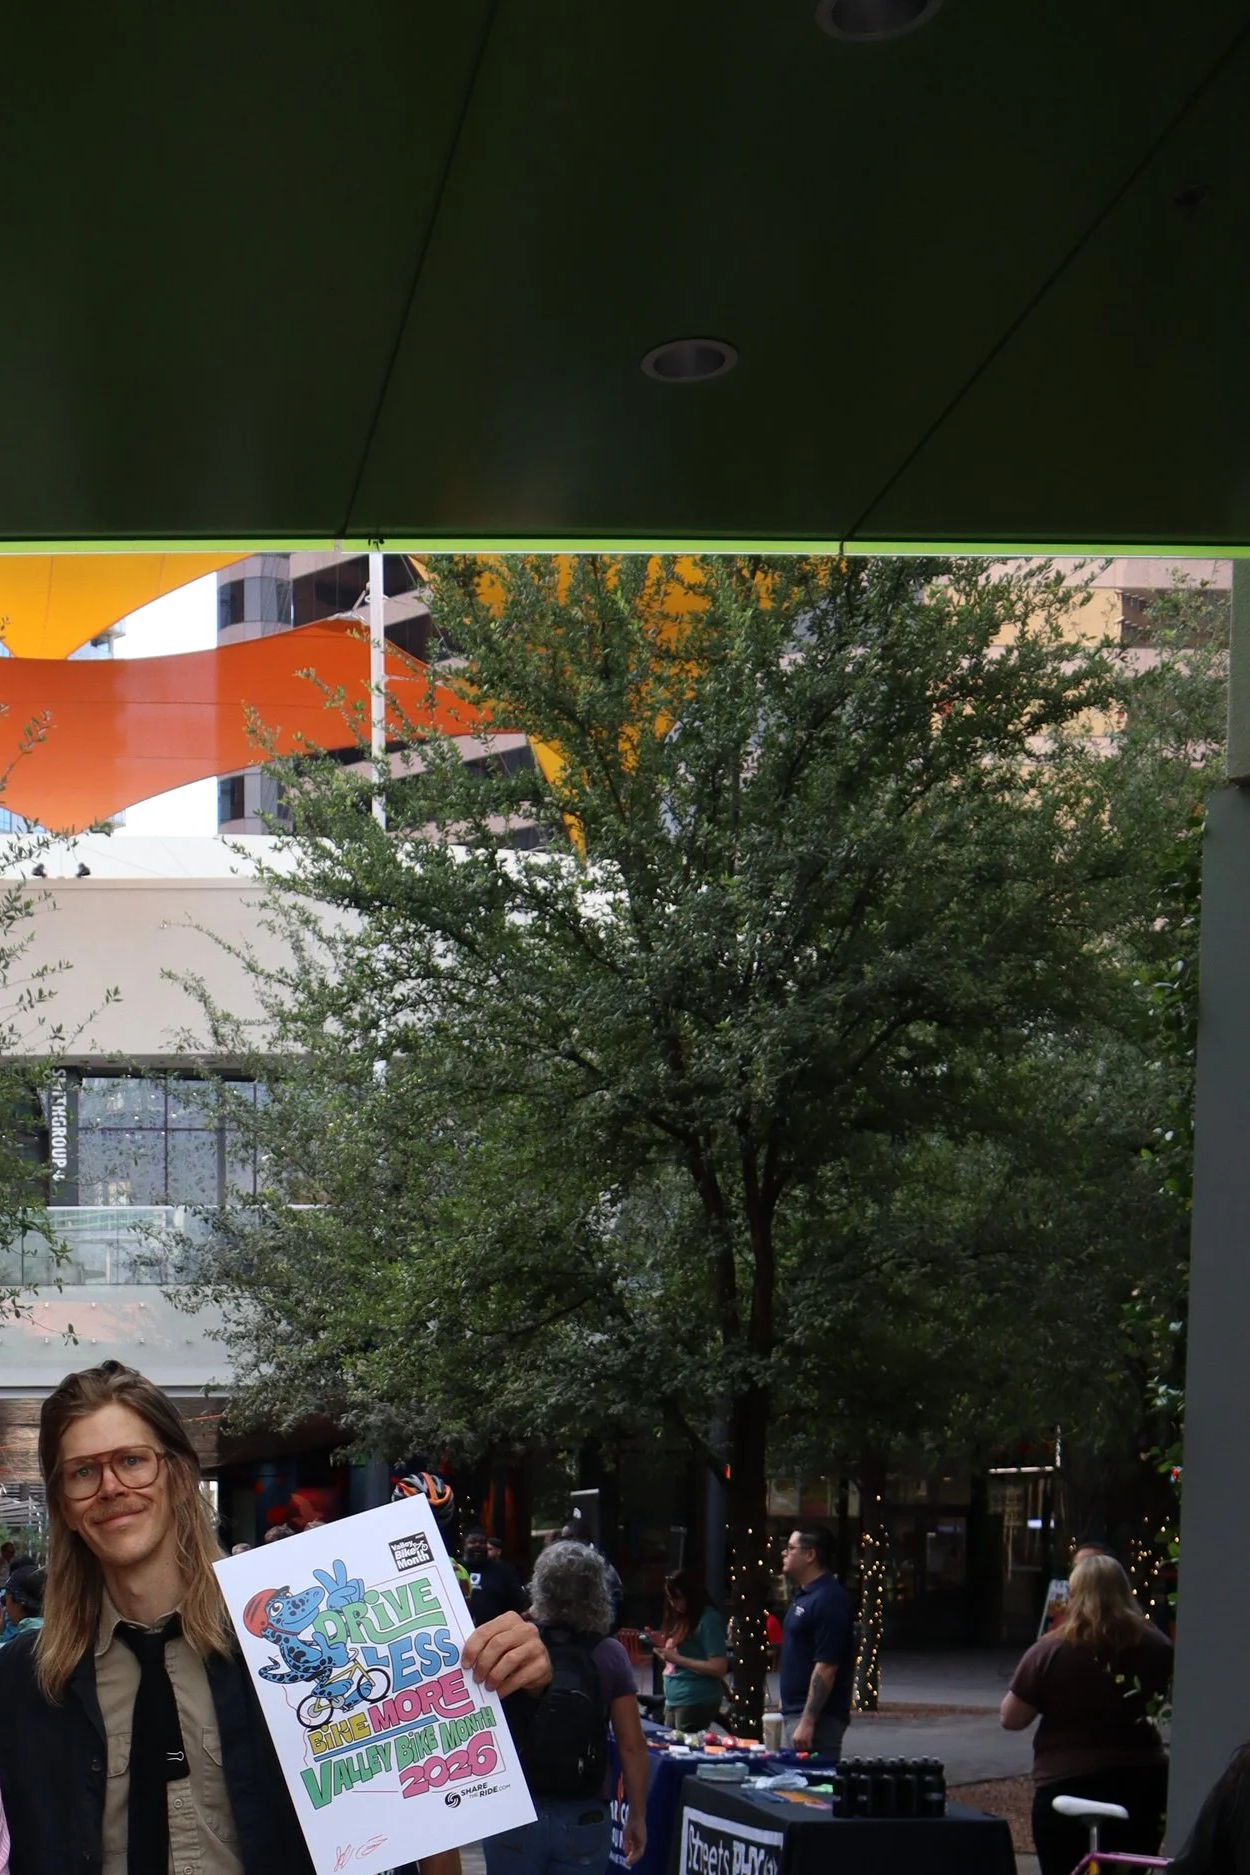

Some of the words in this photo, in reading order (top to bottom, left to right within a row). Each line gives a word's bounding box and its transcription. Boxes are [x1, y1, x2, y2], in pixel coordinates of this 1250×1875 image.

[391, 1540, 414, 1551] Valley
[394, 1547, 417, 1560] Bike
[396, 1549, 430, 1569] Month
[361, 1628, 460, 1693] LESS
[368, 1668, 476, 1733] MORE
[300, 1741, 393, 1810] VALLEY
[439, 1705, 498, 1755] MONTH
[399, 1730, 498, 1799] 2026
[461, 1782, 488, 1797] SHARE
